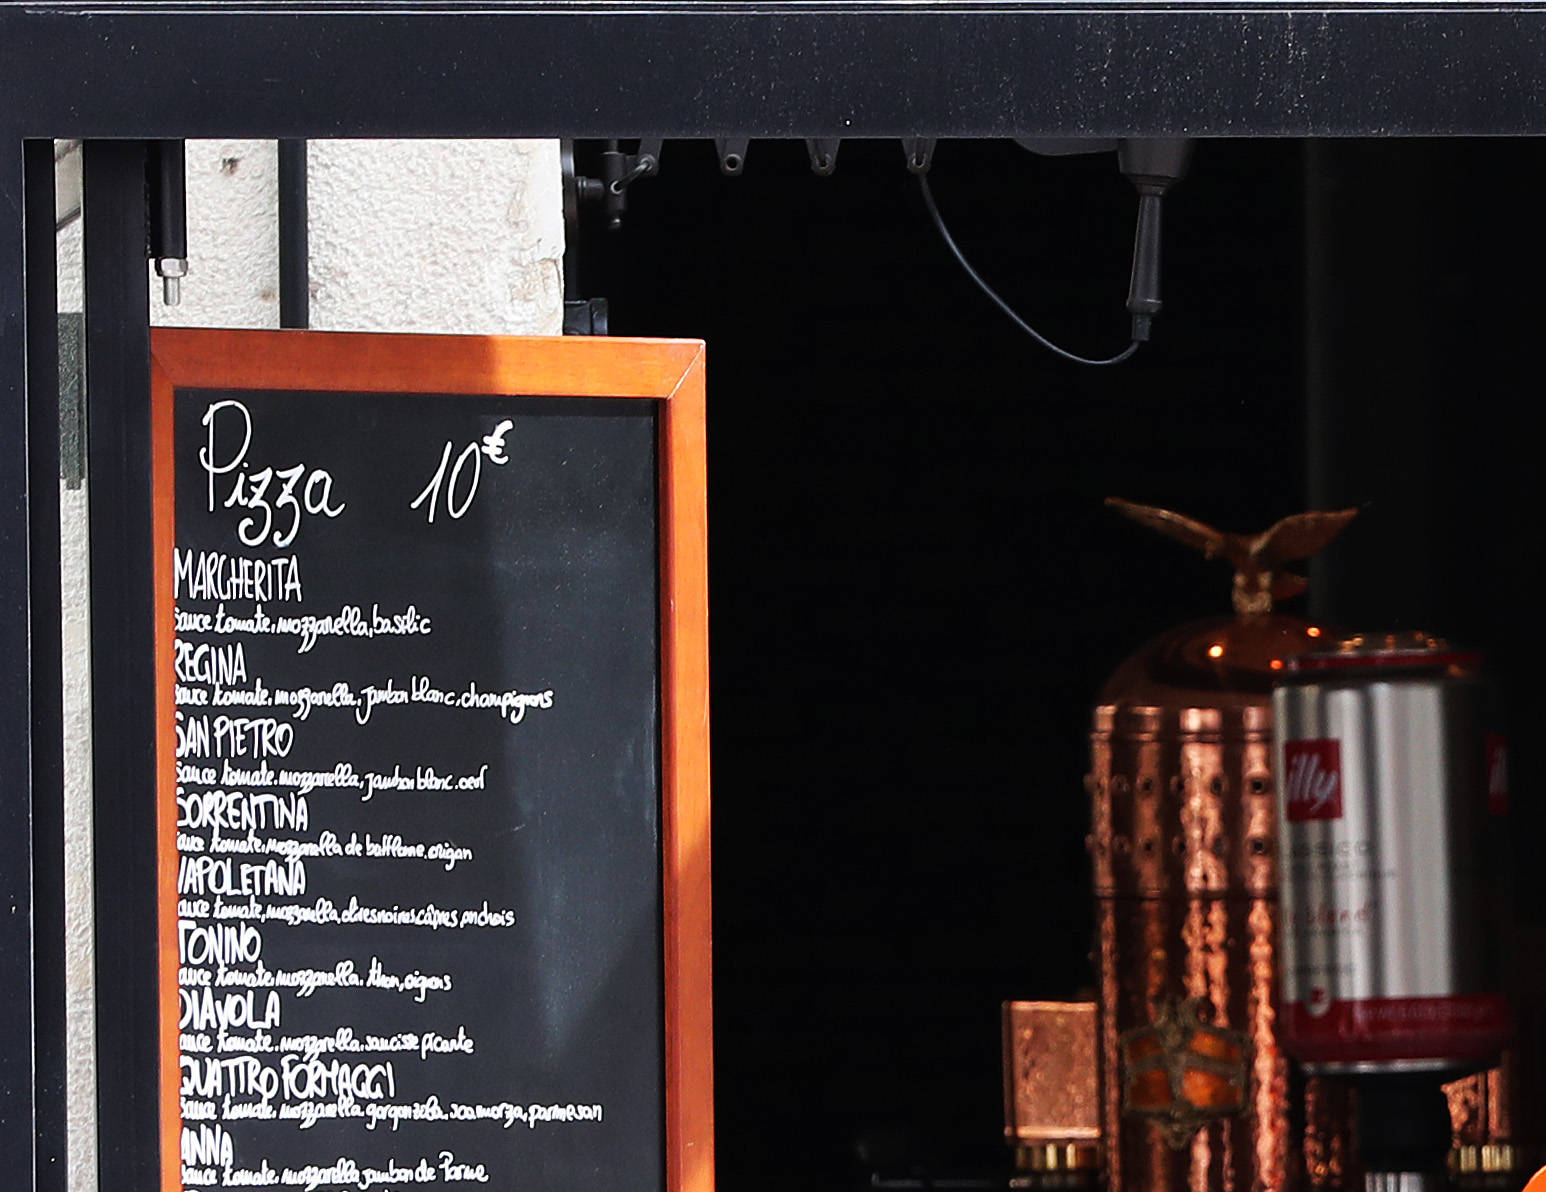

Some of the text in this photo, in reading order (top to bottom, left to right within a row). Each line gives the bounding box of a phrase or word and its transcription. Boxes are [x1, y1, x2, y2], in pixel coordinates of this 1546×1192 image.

[200, 400, 345, 546] Pizza
[174, 548, 302, 601] MARGHERITA
[214, 715, 293, 758] PIETRO
[1286, 752, 1338, 813] illy
[178, 919, 261, 965] TONINO
[180, 1054, 395, 1100] QUATTRO FORMAGGI
[181, 1124, 233, 1166] ANNA
